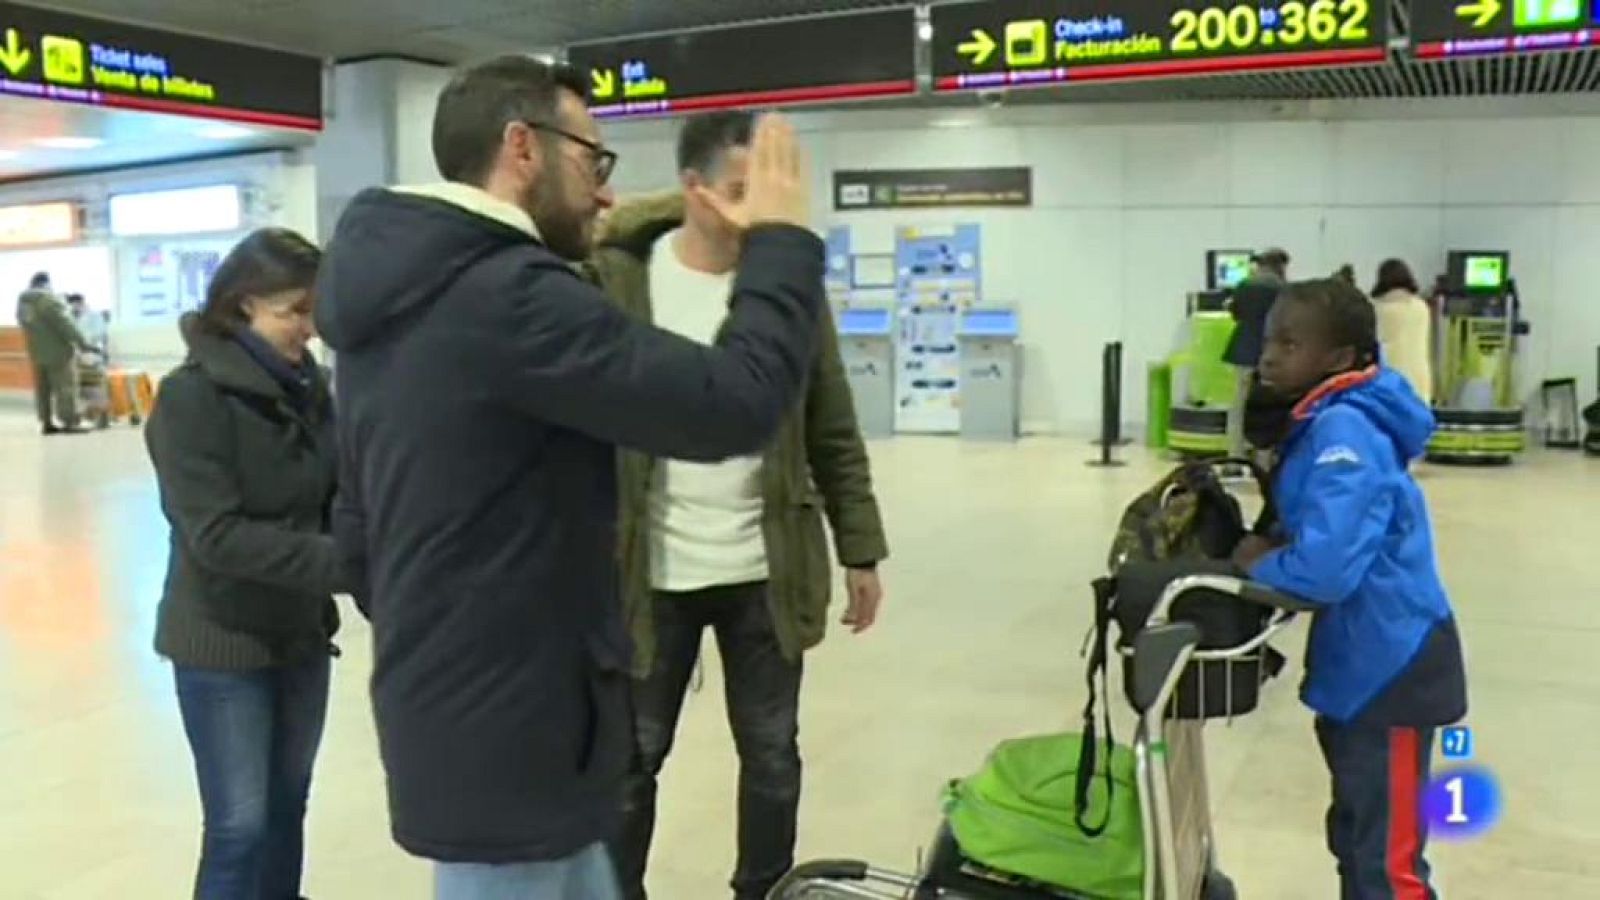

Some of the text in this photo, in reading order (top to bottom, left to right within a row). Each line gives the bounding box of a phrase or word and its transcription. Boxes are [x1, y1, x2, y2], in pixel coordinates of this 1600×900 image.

[1055, 16, 1122, 36] Check-in
[1170, 5, 1257, 51] 200
[1279, 0, 1368, 44] 362
[1054, 33, 1161, 59] Facturación
